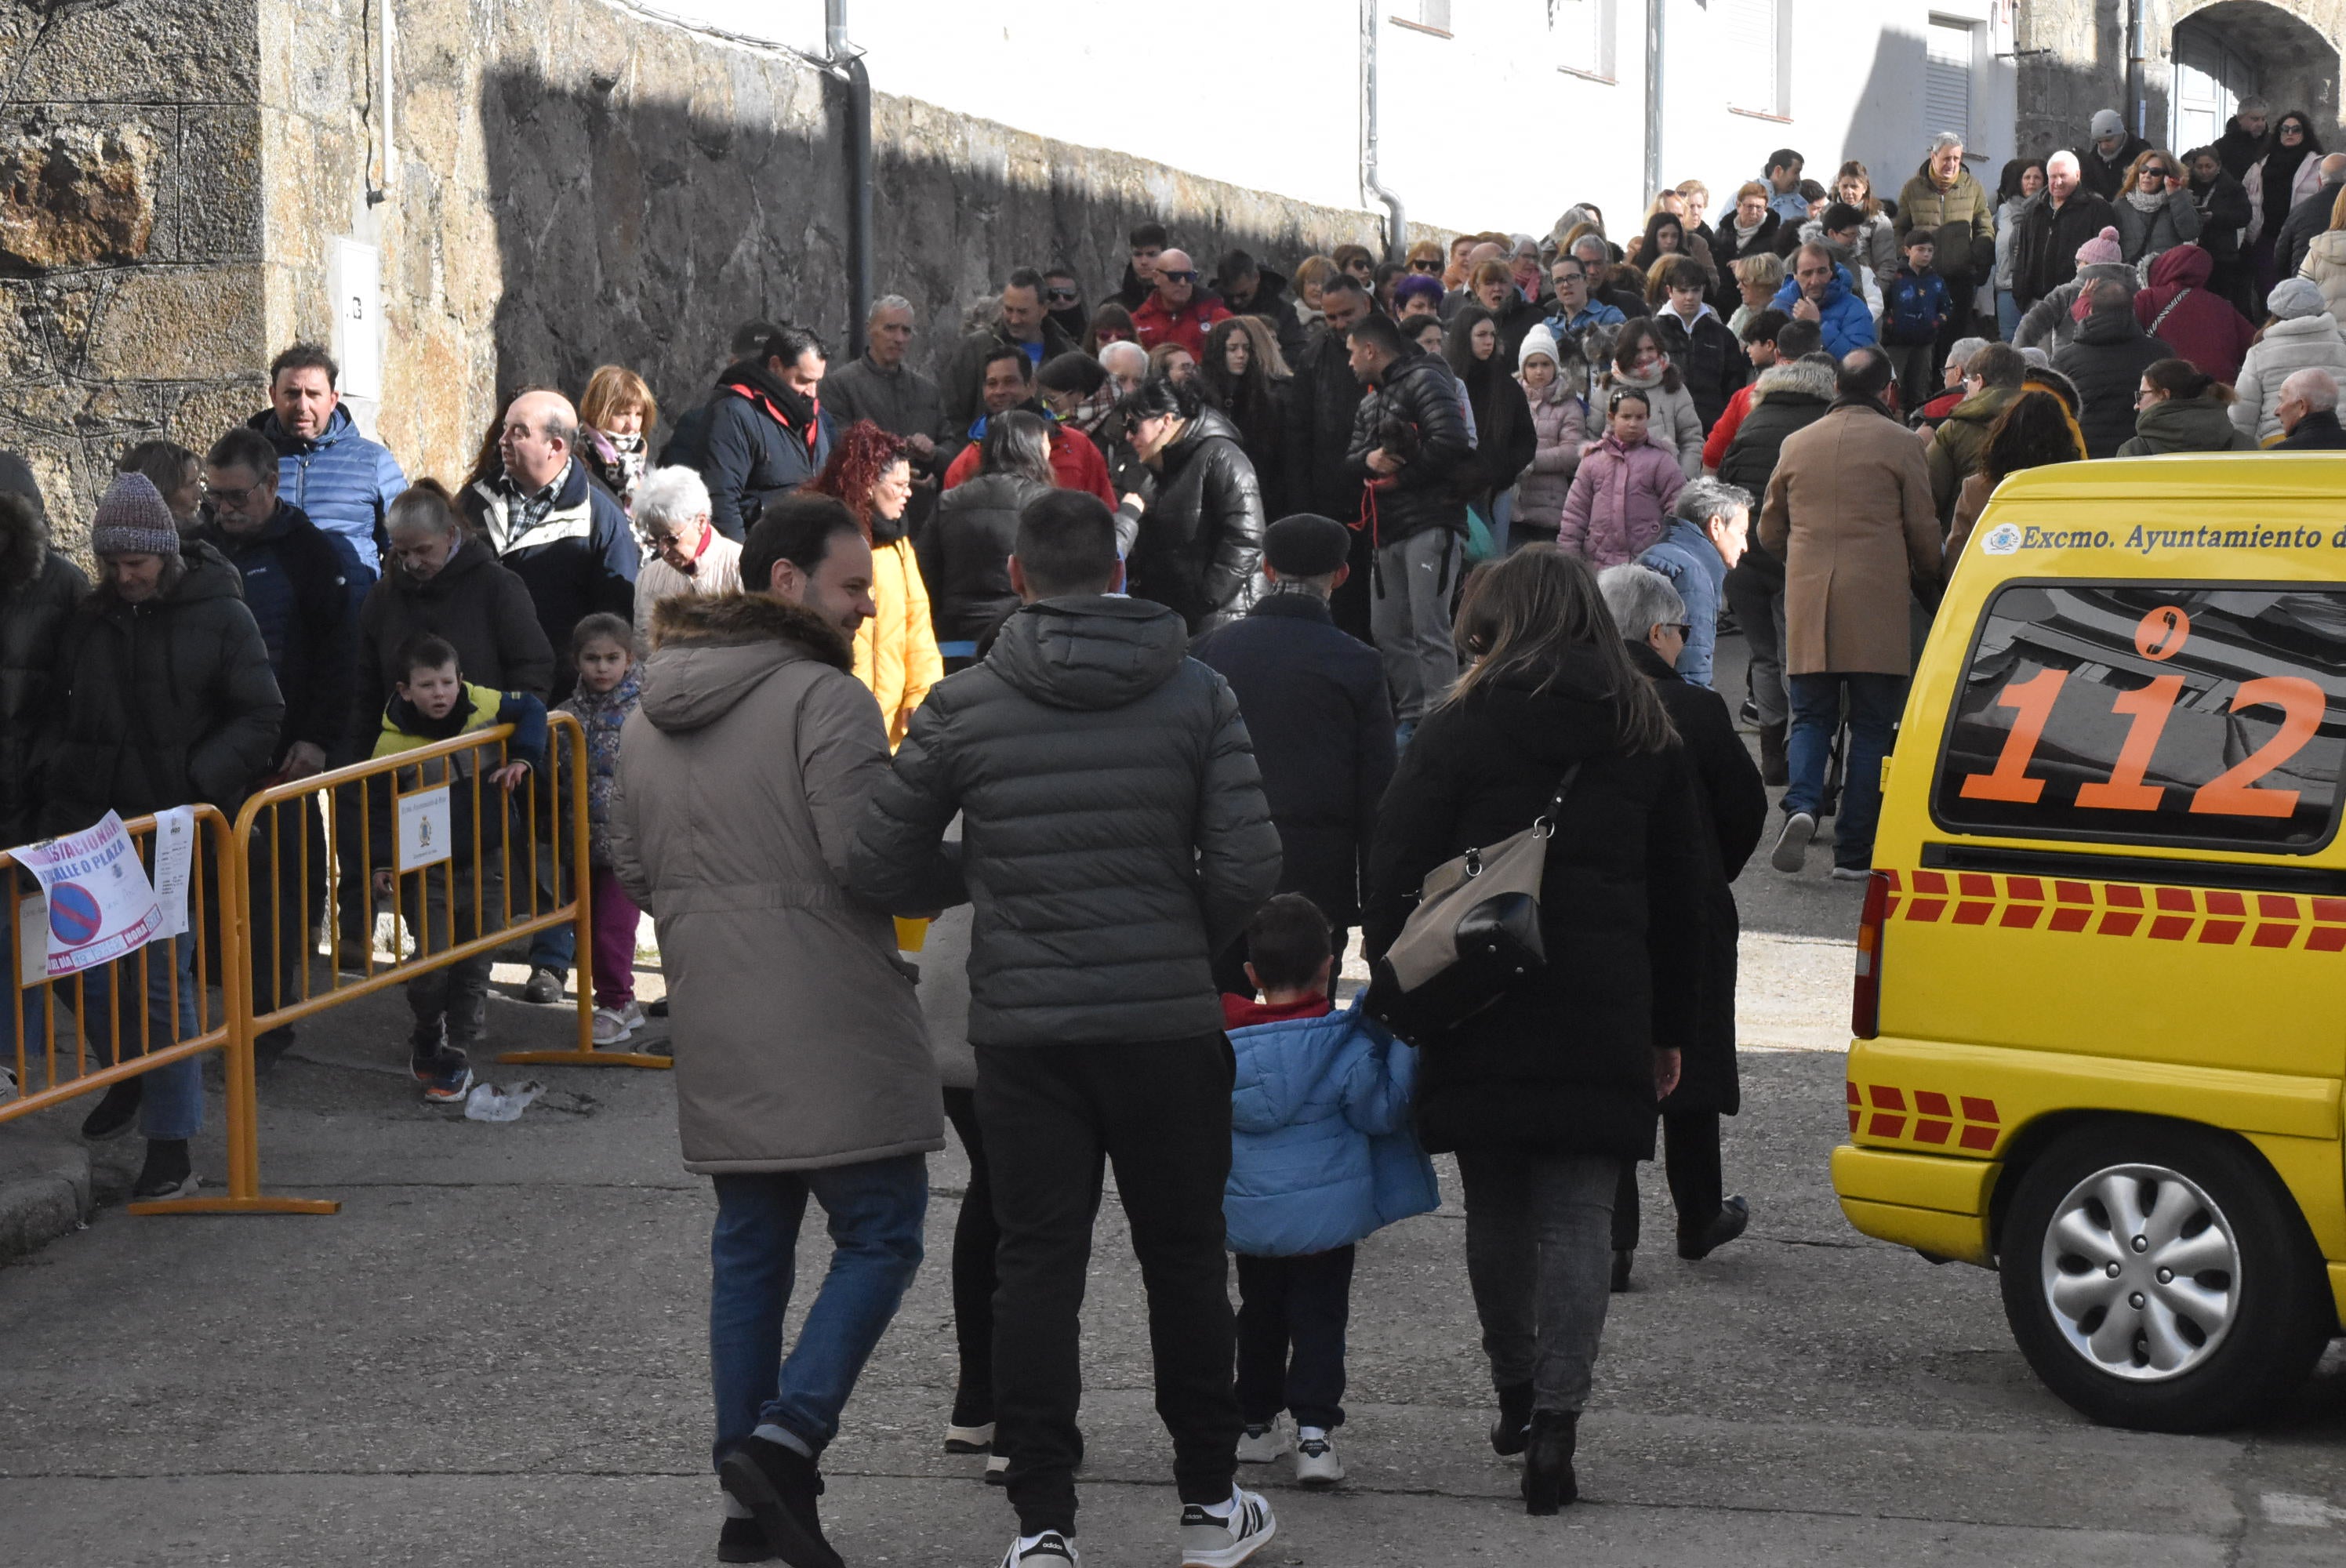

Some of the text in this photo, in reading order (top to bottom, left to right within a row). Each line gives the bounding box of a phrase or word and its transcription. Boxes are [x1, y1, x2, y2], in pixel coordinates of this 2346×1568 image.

[2021, 526, 2115, 550] Excmo.
[2125, 524, 2322, 554] Ayuntamiento
[1959, 669, 2326, 818] 112
[80, 859, 92, 873] O
[91, 838, 125, 869] PLAZA
[125, 920, 148, 944] HORA
